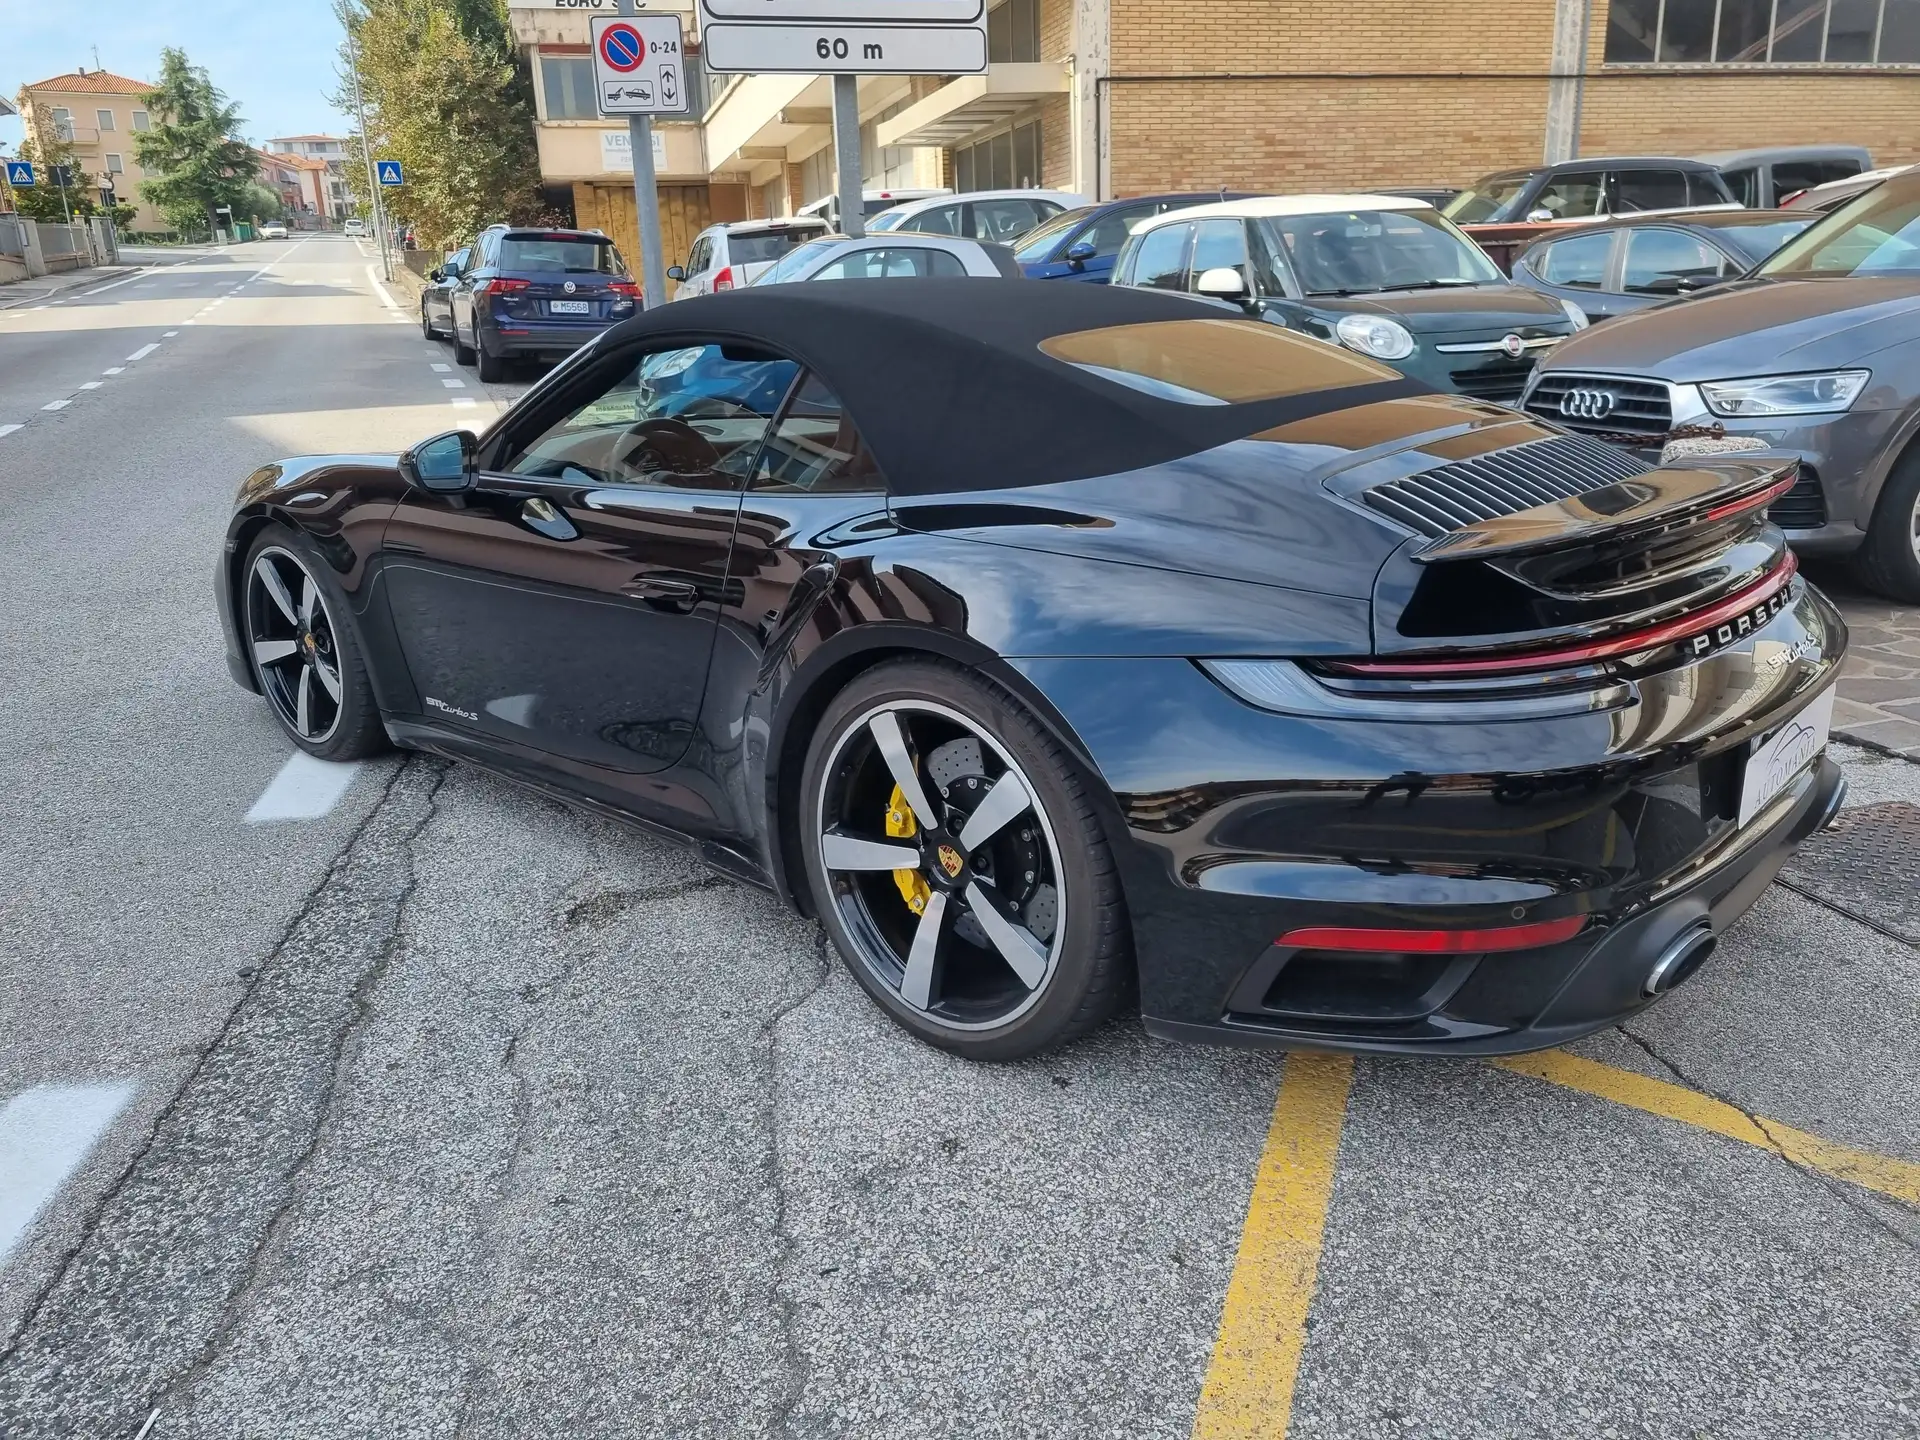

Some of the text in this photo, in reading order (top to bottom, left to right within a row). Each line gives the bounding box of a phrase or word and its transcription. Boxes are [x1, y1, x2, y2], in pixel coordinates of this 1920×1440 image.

[650, 41, 677, 54] 0-24
[817, 38, 883, 59] 60 m
[1755, 737, 1816, 808] AUTOMANIA
